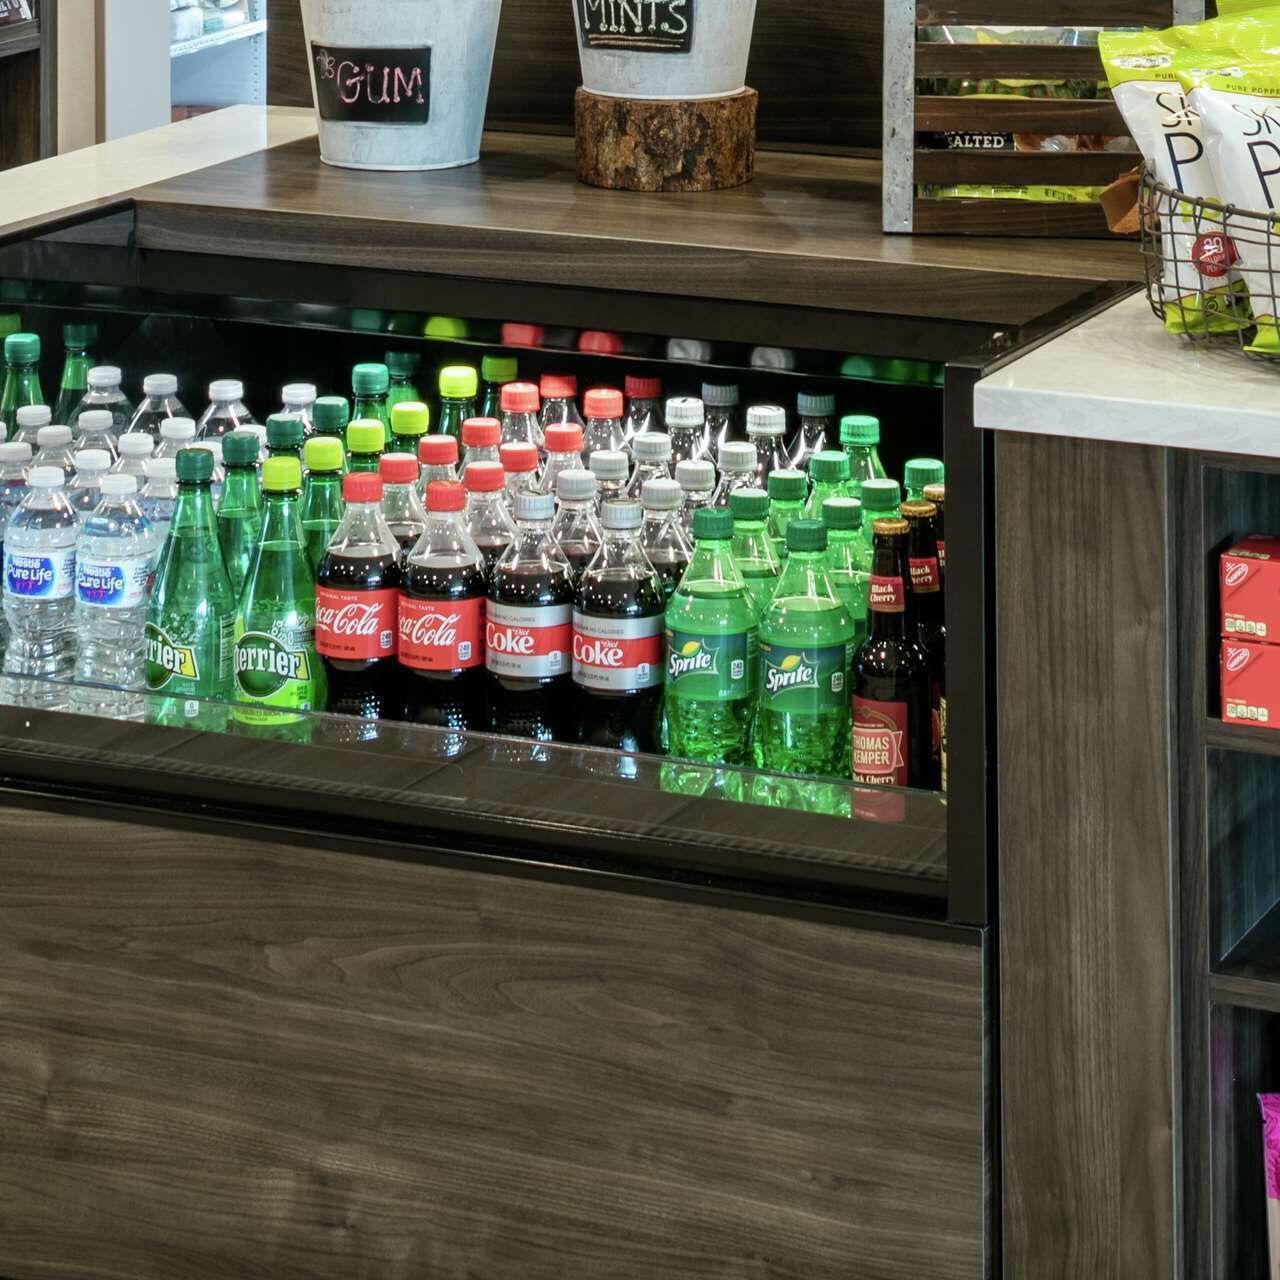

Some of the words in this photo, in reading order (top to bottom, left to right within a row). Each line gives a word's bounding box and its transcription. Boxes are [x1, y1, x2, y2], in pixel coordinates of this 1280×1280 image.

[336, 59, 424, 104] GUM
[7, 565, 29, 579] Pure
[30, 569, 52, 582] Life
[101, 578, 123, 593] Life
[871, 583, 894, 595] Black
[870, 592, 896, 604] Cherry
[486, 622, 534, 654] Coke
[602, 640, 619, 648] Diet
[572, 635, 624, 667] Coke
[669, 650, 713, 676] Sprite
[732, 661, 743, 670] 240
[765, 664, 816, 692] Sprite
[832, 674, 843, 683] 240
[866, 774, 895, 786] Cherry
